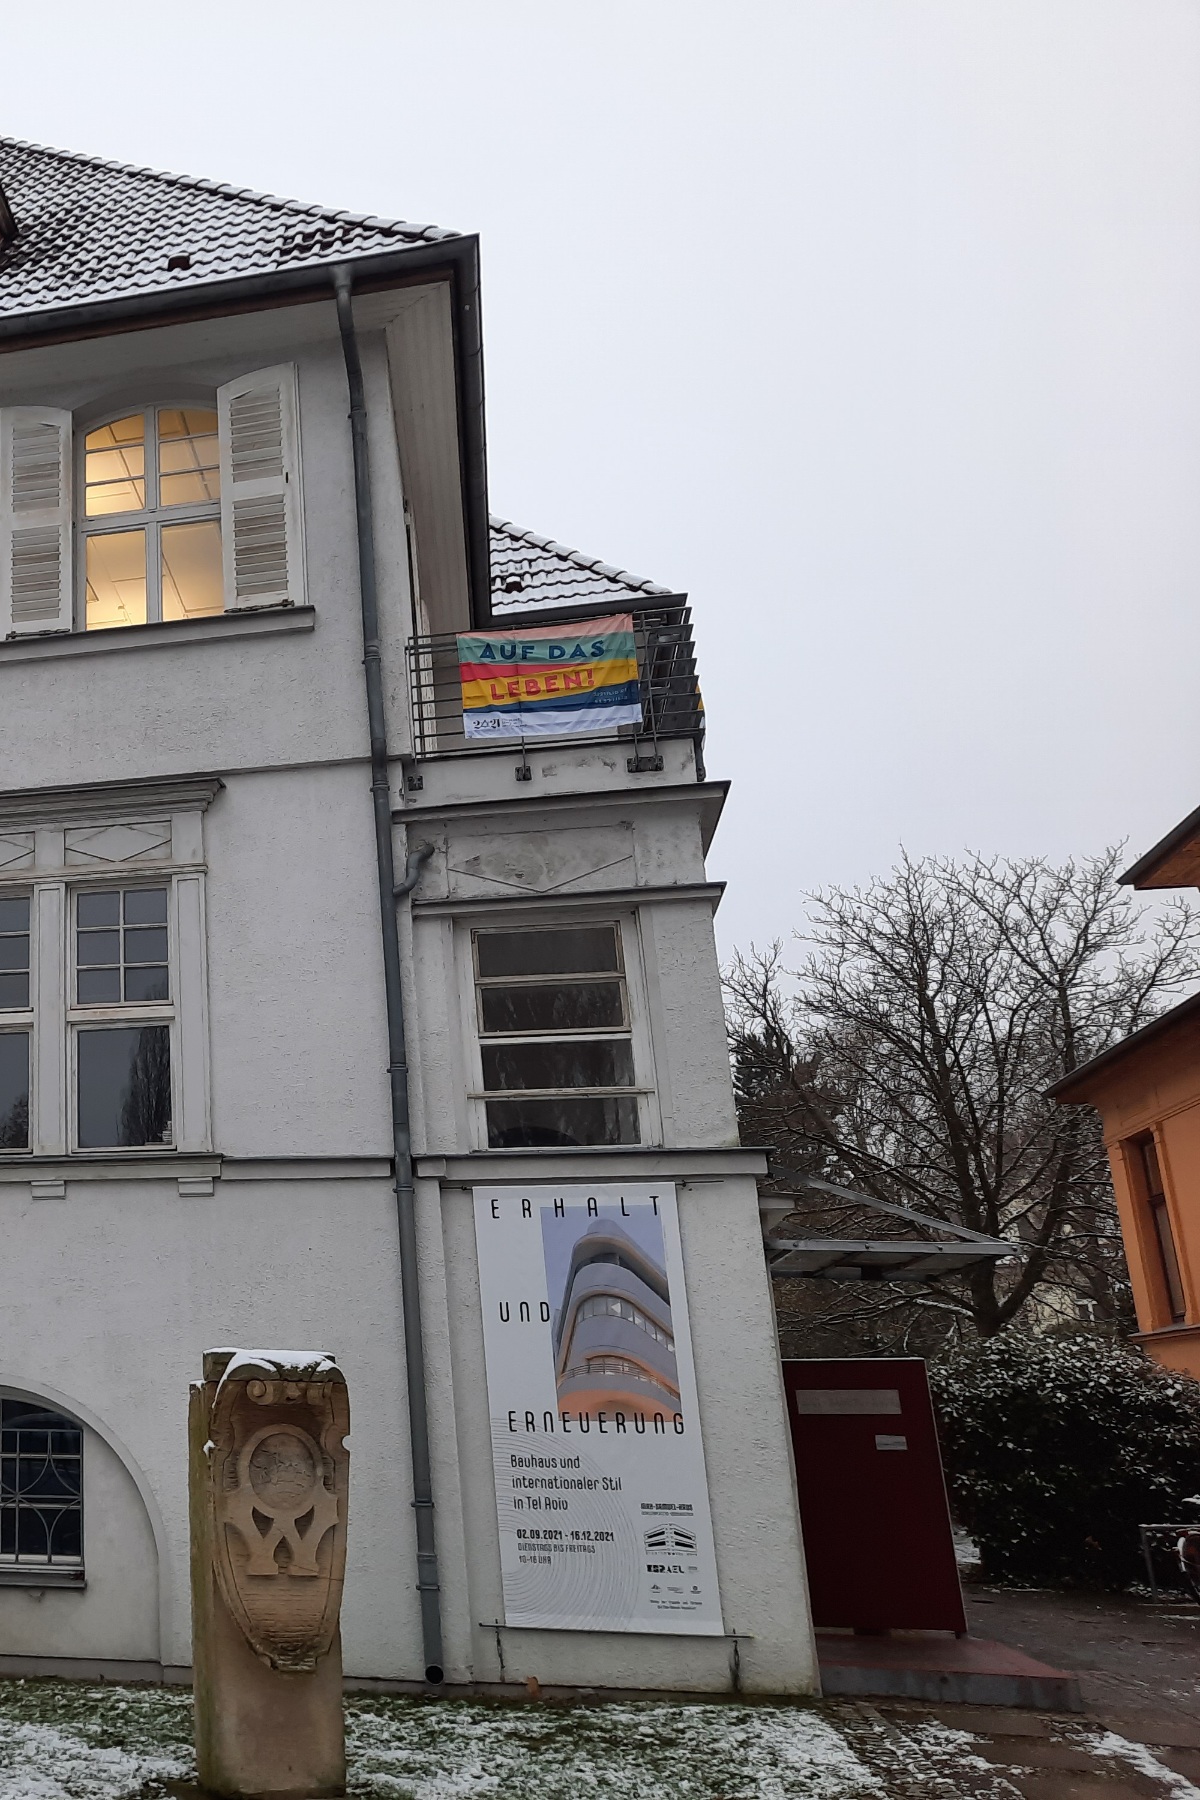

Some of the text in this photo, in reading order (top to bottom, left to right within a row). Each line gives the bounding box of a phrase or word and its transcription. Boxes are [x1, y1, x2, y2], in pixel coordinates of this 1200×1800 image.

[480, 641, 605, 659] AUF DAS
[490, 668, 594, 700] LEBEN!
[491, 1196, 659, 1219] ERHALT
[500, 1301, 550, 1322] UND
[508, 1411, 684, 1435] ERNEUERUNG
[510, 1454, 580, 1469] Bauhaus und
[512, 1475, 622, 1491] internationaler Stil
[525, 1495, 542, 1511] Tel
[544, 1496, 568, 1510] Aviv
[516, 1529, 563, 1540] 02.09.2021
[570, 1530, 615, 1541] 16.12.2021
